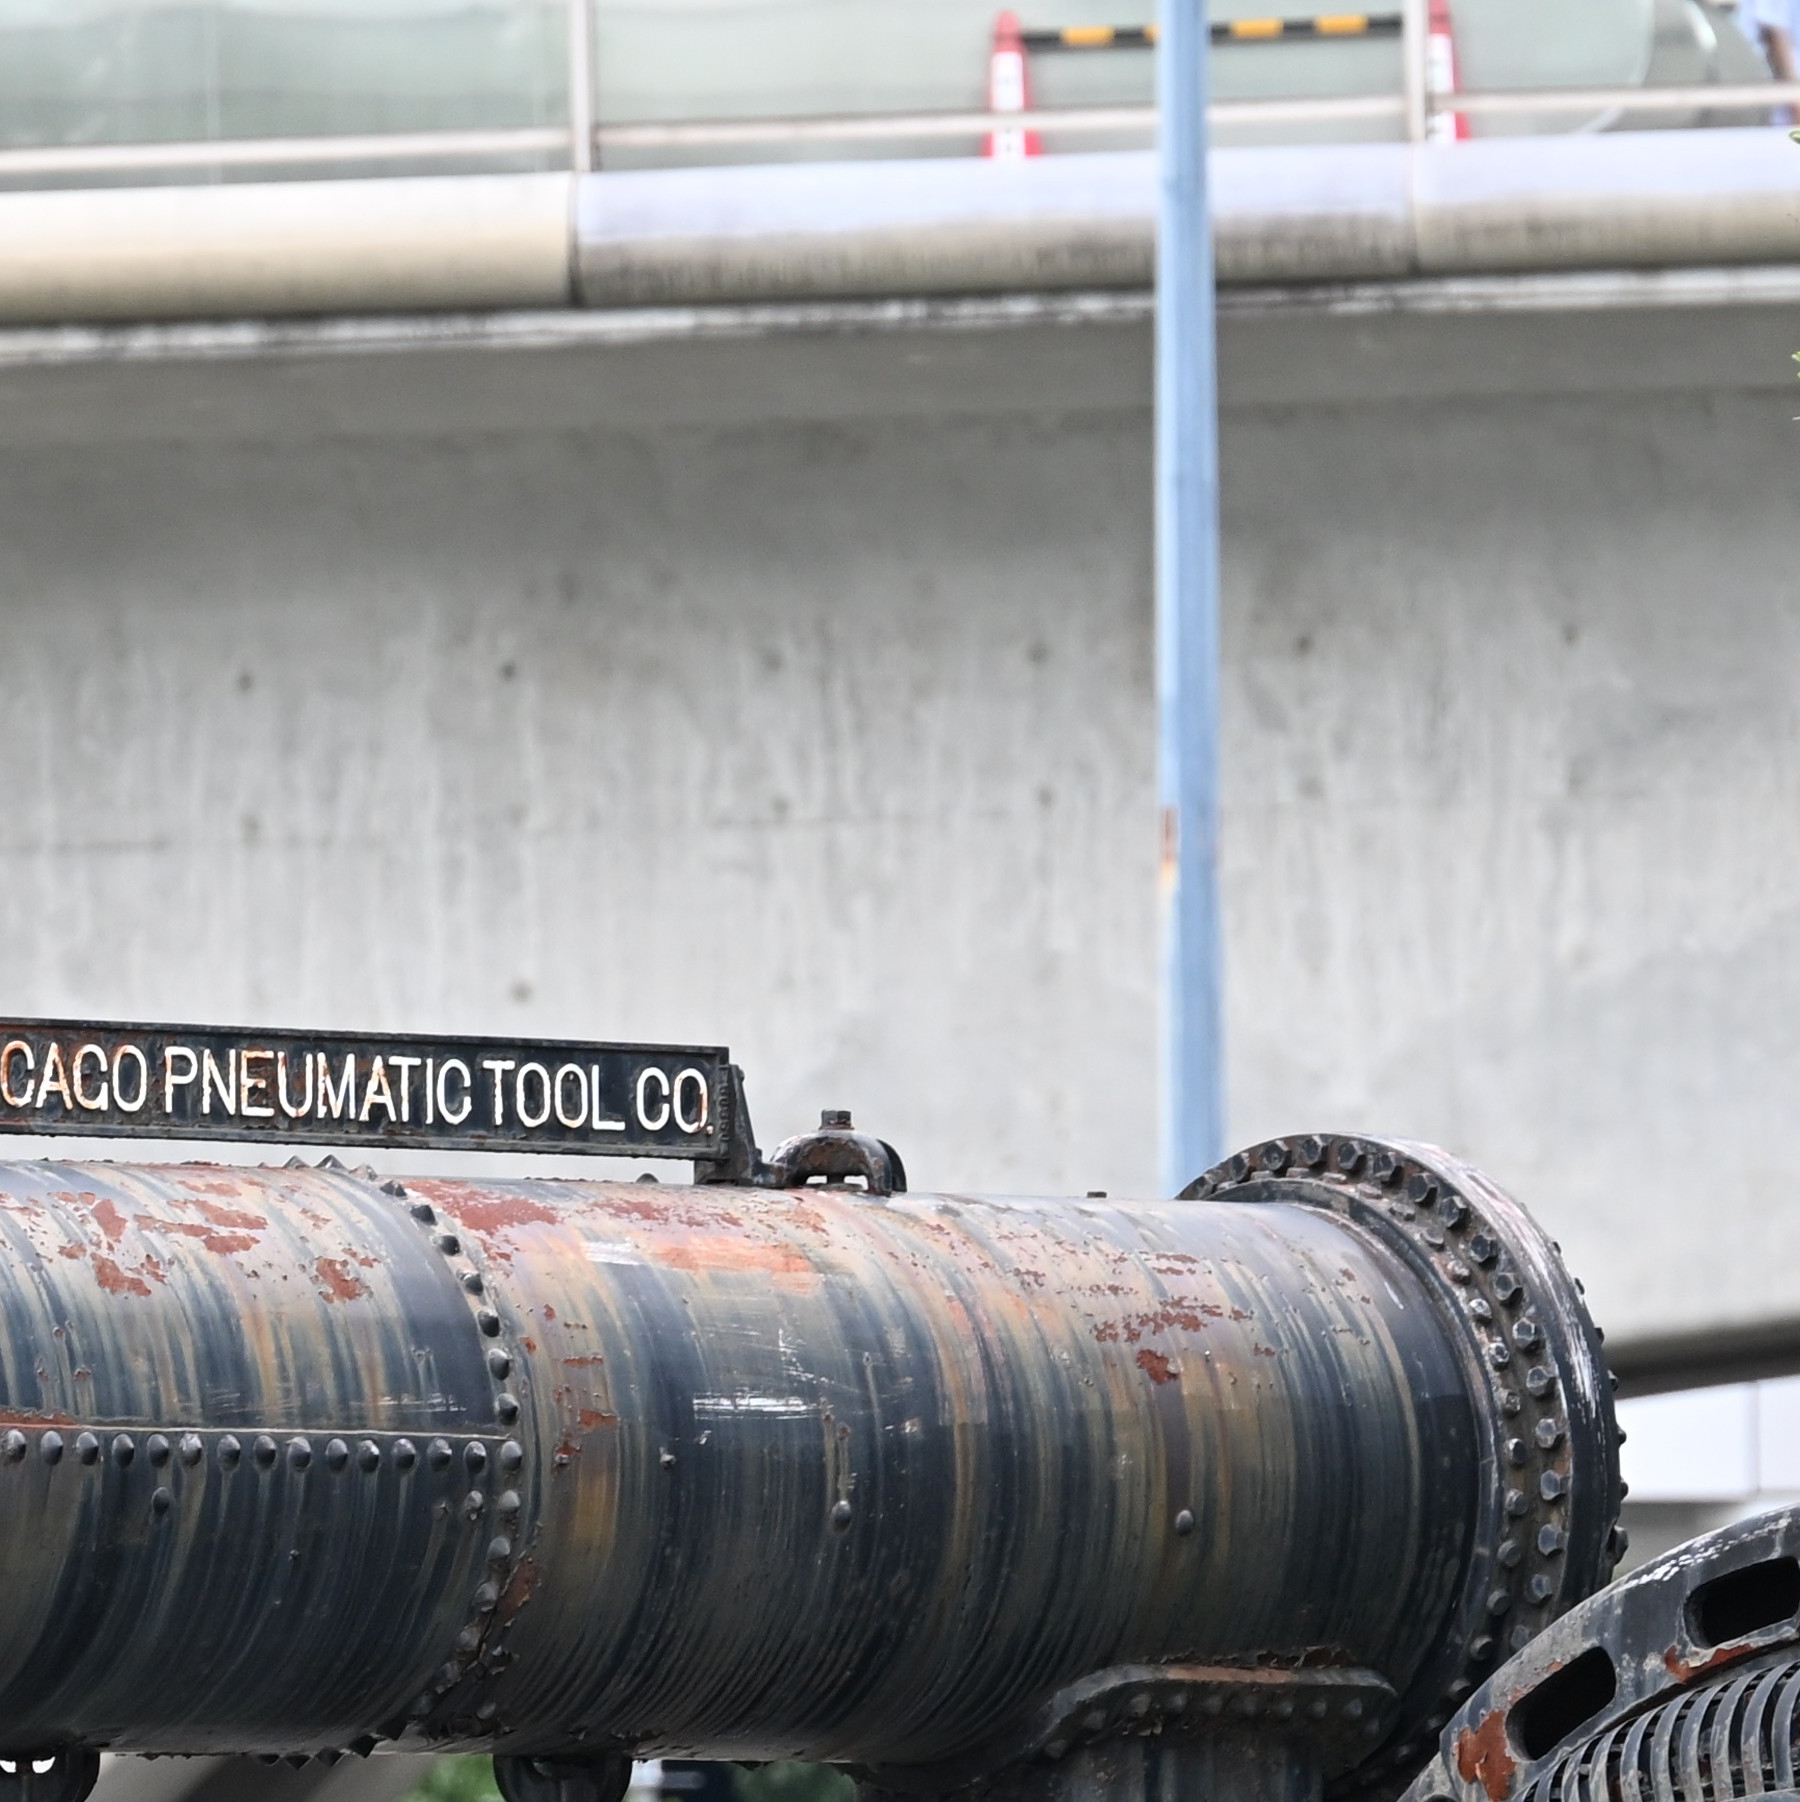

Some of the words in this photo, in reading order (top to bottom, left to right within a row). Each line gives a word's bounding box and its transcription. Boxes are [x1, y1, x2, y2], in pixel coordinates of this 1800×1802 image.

[165, 1045, 473, 1125] PNEUMATIC
[483, 1060, 626, 1131] TOOL
[636, 1067, 714, 1134] CO.
